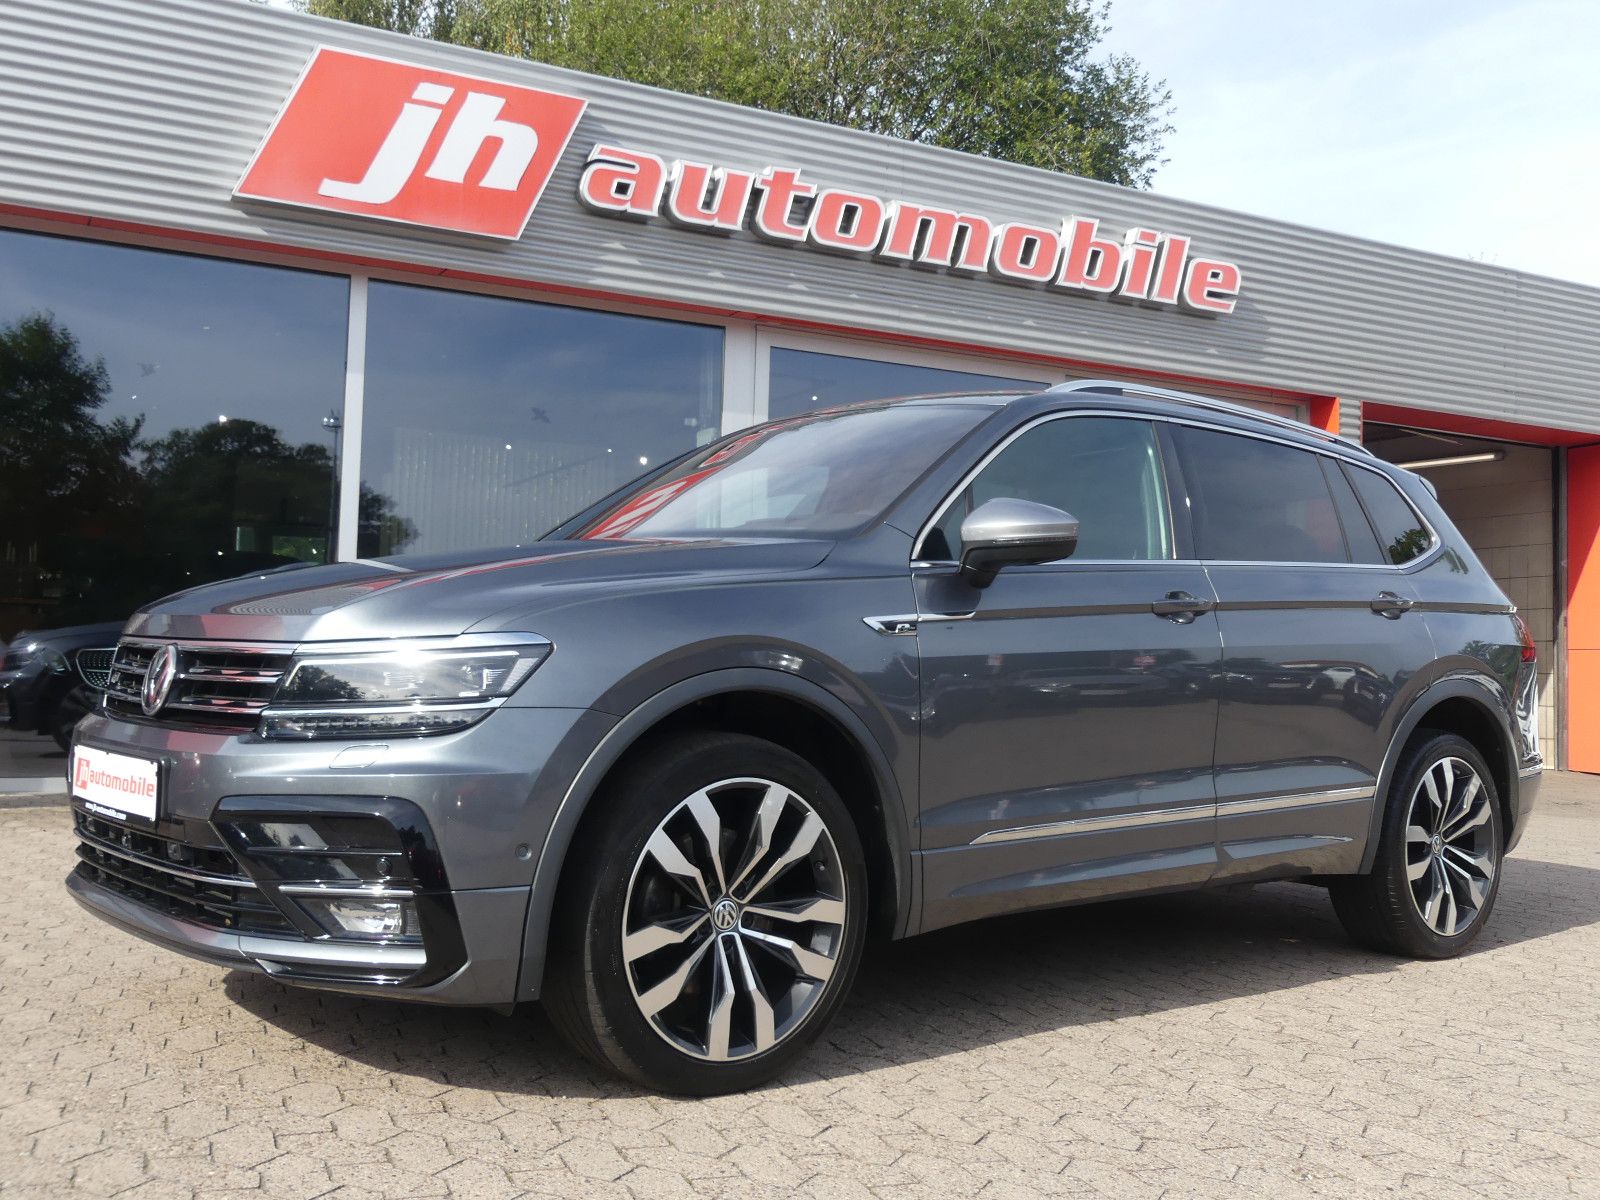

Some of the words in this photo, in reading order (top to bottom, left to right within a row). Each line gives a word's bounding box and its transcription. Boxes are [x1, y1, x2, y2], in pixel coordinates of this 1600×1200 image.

[317, 82, 539, 204] jh
[579, 143, 1242, 314] automobile
[89, 769, 155, 797] automobile
